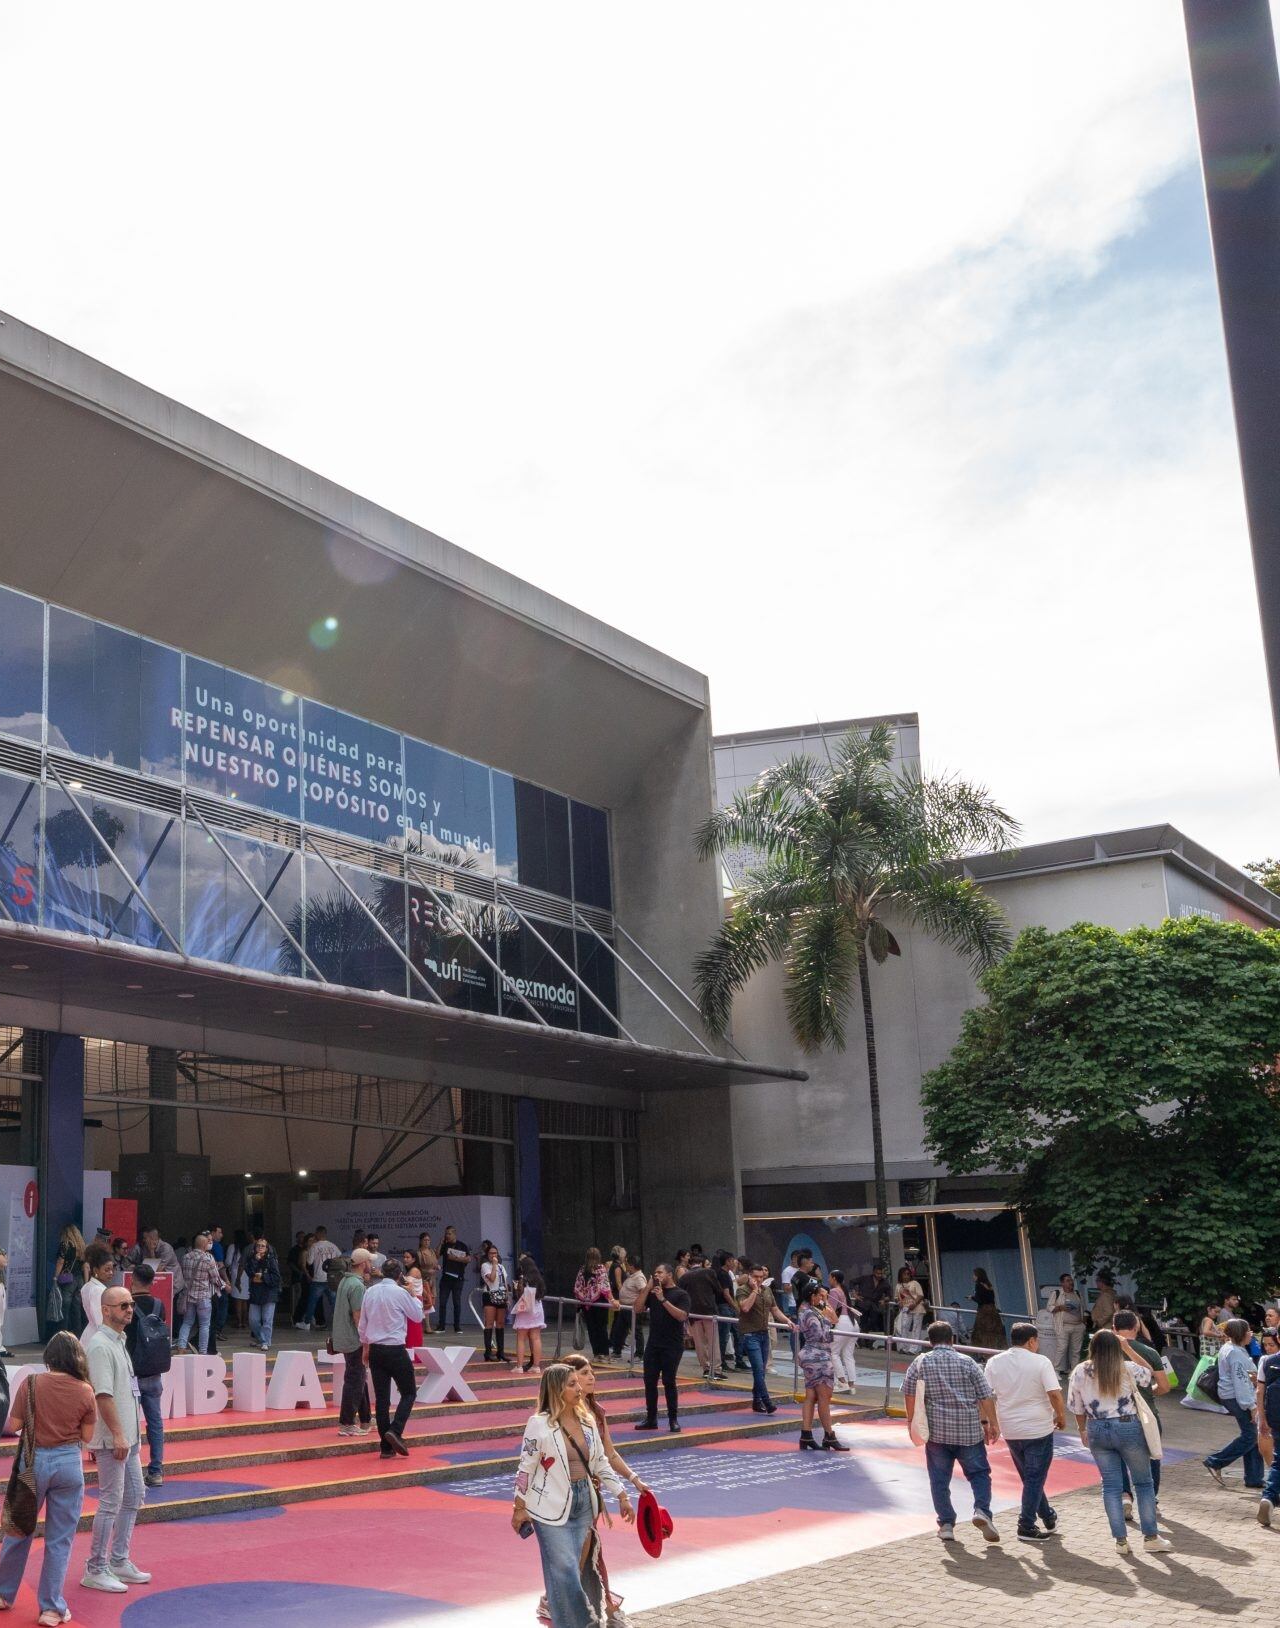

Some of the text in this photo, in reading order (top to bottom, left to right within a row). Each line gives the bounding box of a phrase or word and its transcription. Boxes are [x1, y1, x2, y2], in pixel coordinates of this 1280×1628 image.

[171, 706, 441, 817] REPENSAR QUIÉNES SOMOS y
[195, 686, 234, 717] Una
[366, 753, 403, 776] para
[184, 740, 491, 854] NUESTRO PROPÓSITO en el mundo
[441, 957, 462, 982] ufi
[502, 969, 575, 1007] inexmoda
